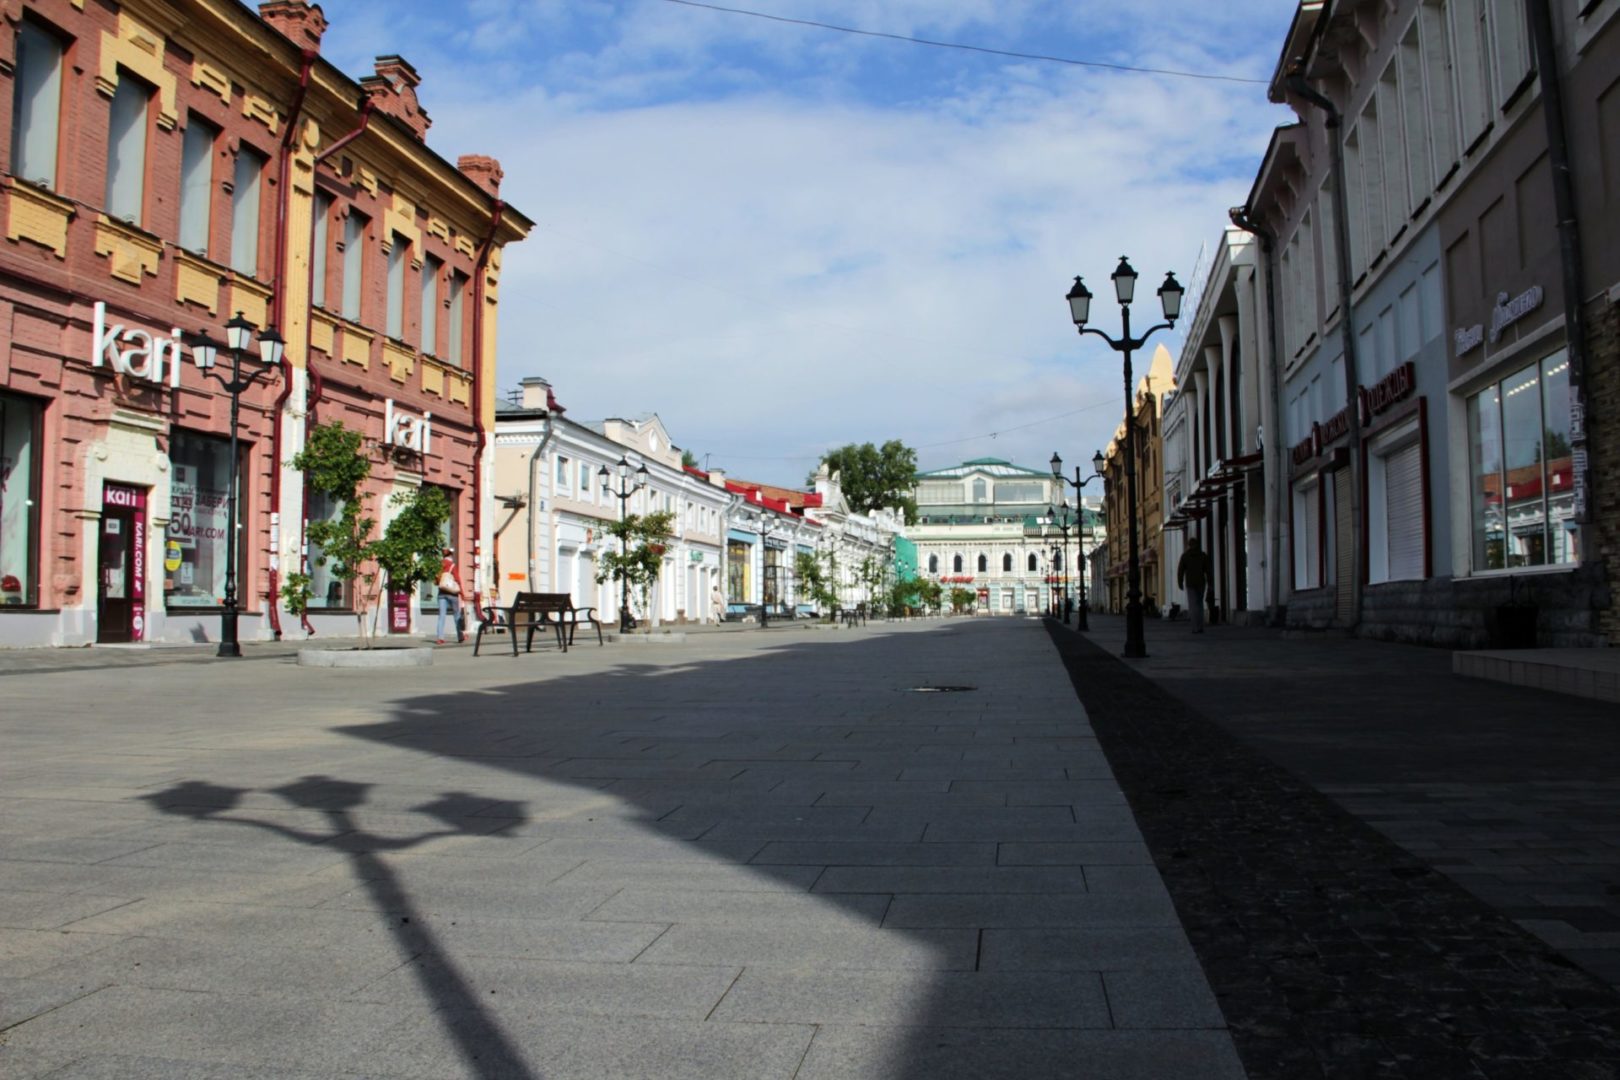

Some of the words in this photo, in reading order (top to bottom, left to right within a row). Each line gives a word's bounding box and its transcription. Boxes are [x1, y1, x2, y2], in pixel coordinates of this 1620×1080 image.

[92, 301, 181, 388] kari
[1367, 361, 1415, 415] ОДЕЖДЫ
[384, 398, 431, 455] kari
[134, 521, 143, 578] KARI.COM
